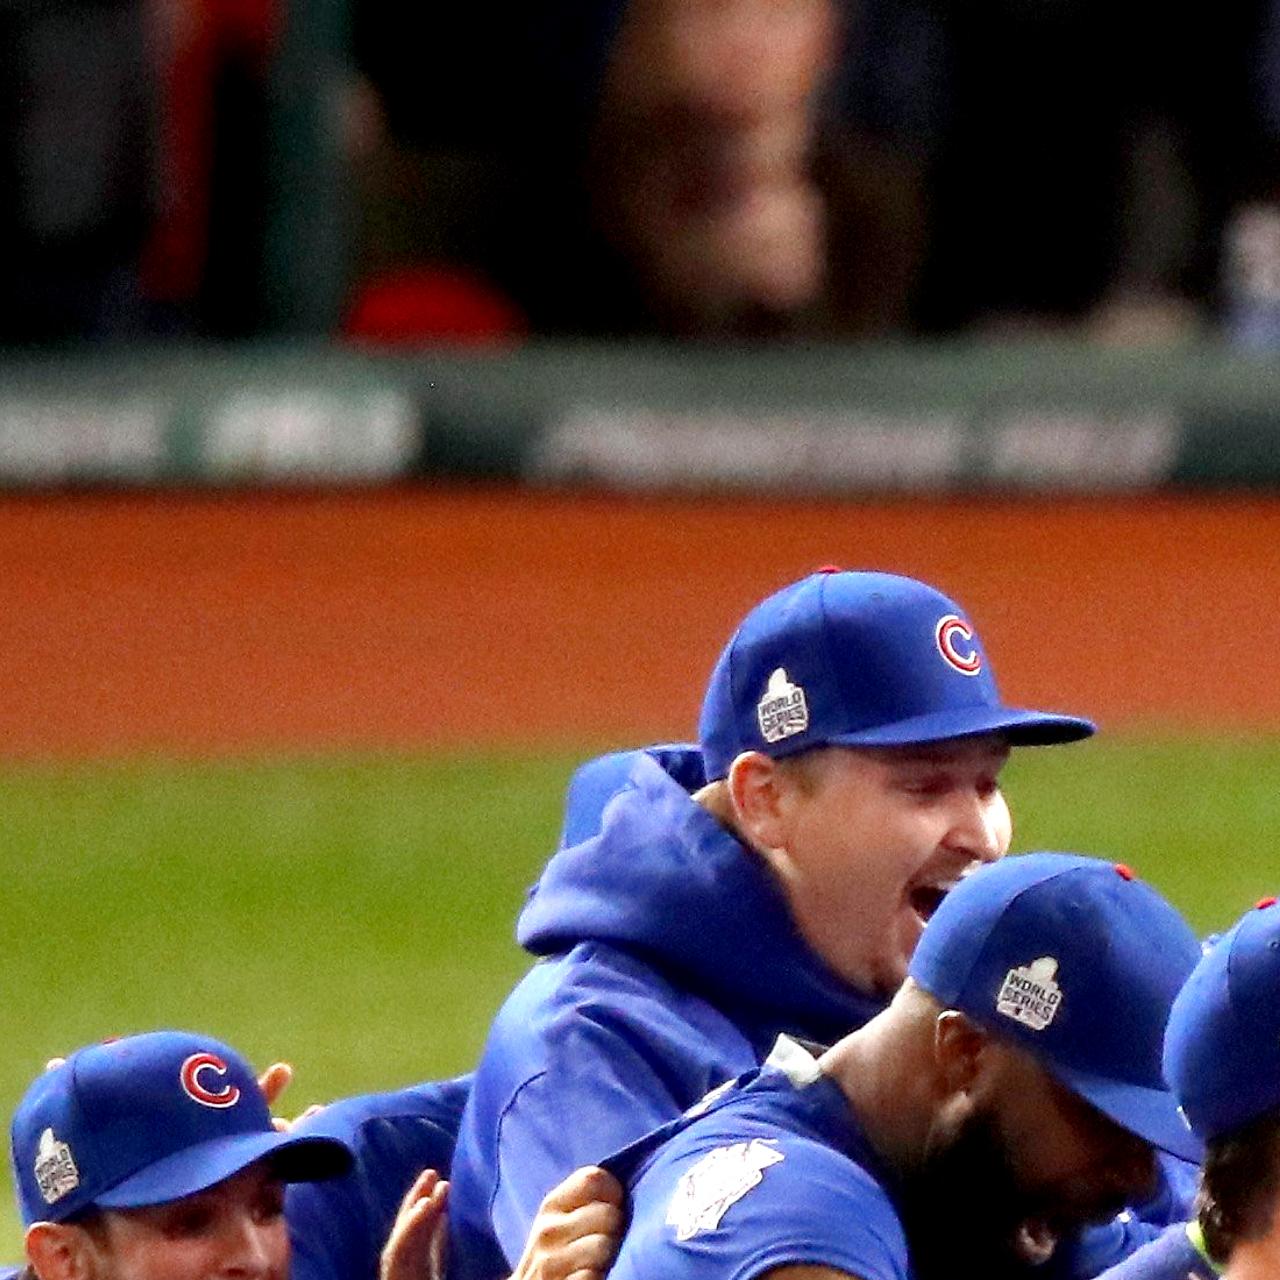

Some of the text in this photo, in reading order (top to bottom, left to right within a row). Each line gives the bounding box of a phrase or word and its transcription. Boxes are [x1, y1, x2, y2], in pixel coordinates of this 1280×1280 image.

[935, 614, 981, 676] C
[760, 690, 802, 717] WORLD
[1008, 973, 1059, 1005] WORLD
[180, 1052, 240, 1109] C
